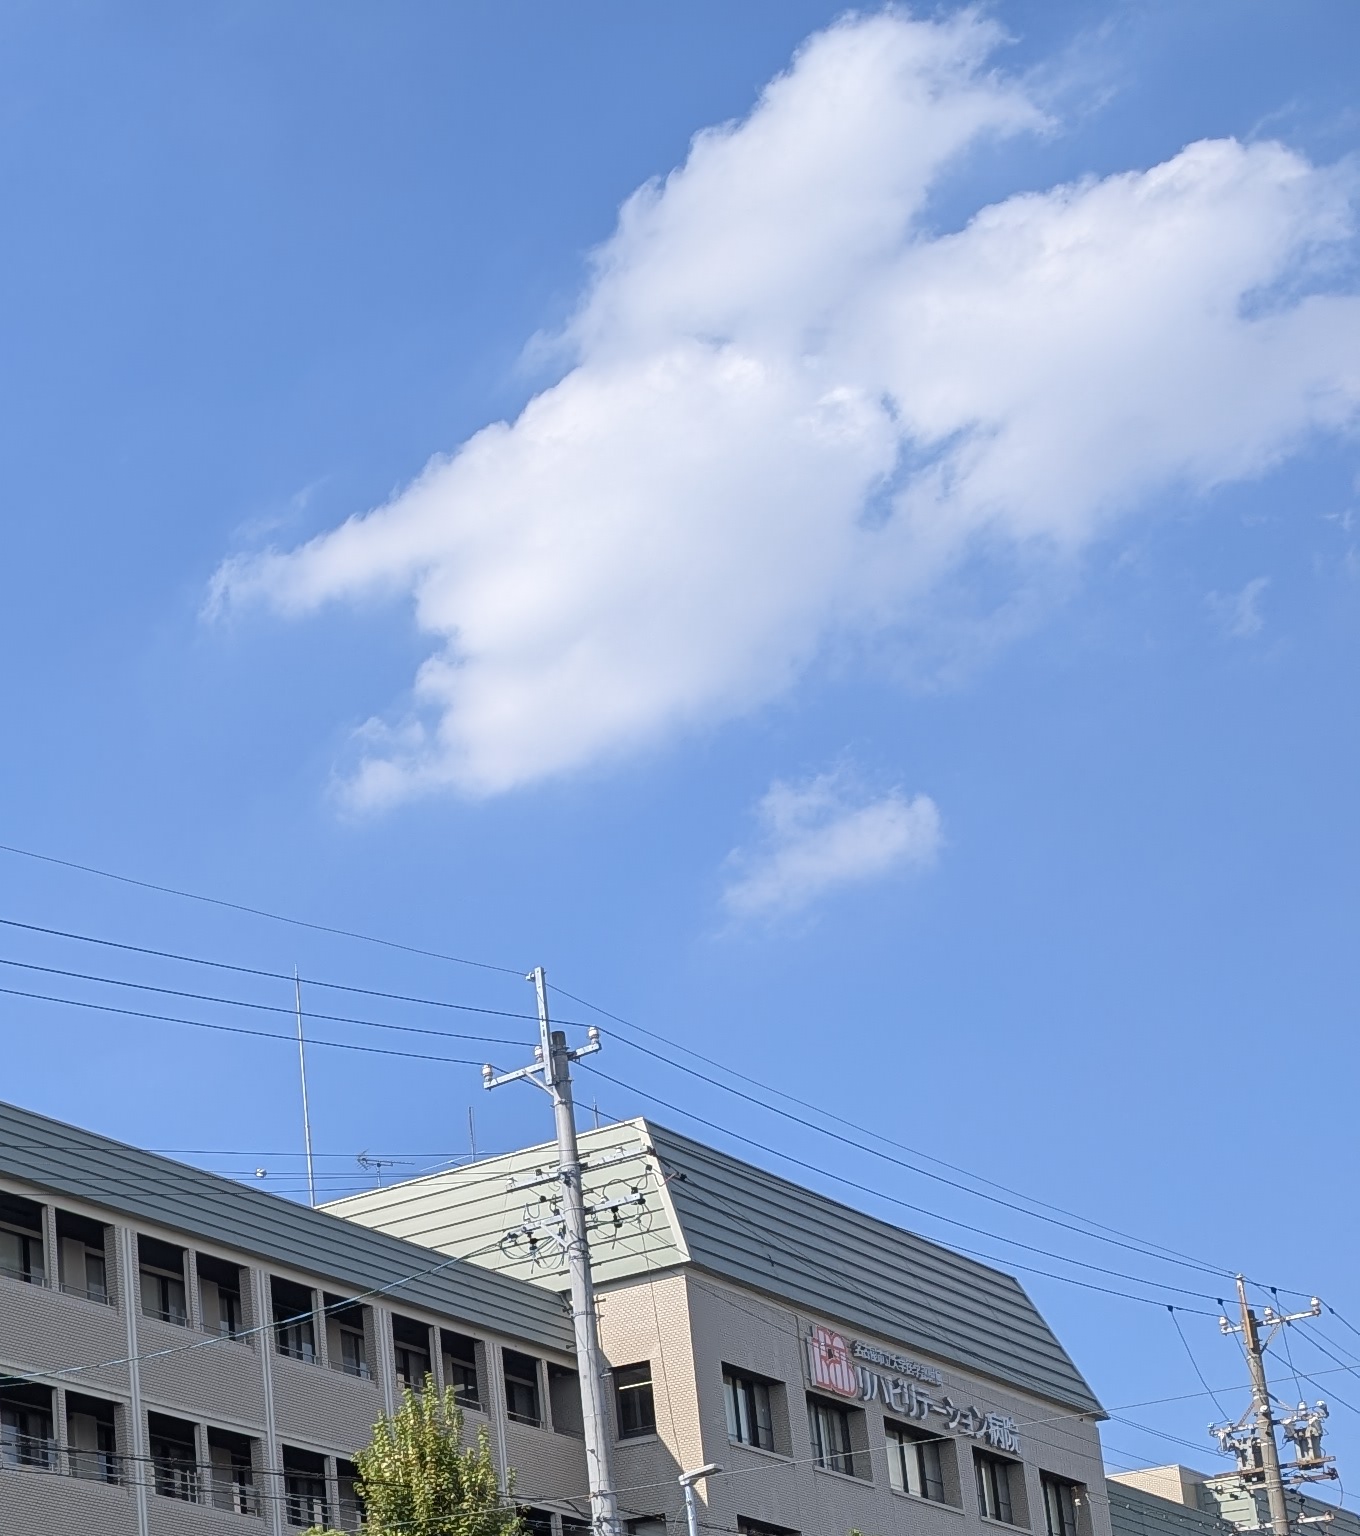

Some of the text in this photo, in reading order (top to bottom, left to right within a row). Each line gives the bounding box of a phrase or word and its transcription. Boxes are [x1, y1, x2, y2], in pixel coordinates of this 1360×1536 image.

[856, 1366, 1022, 1454] リハビリテーション病院
